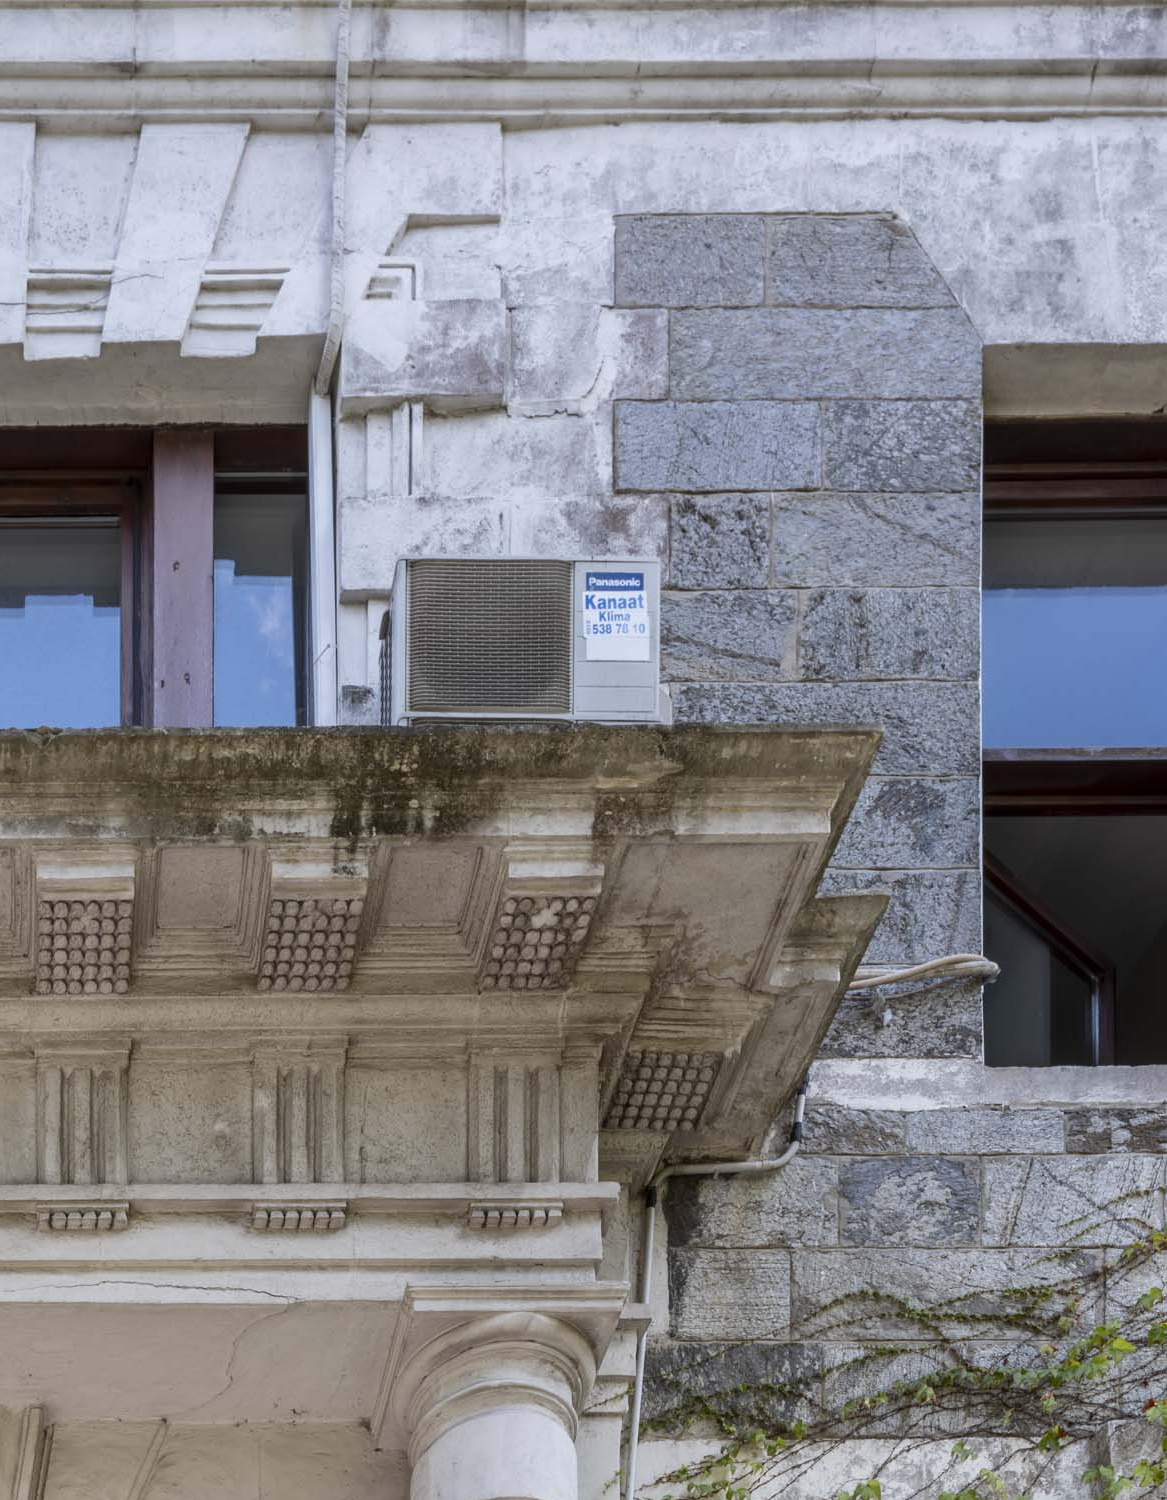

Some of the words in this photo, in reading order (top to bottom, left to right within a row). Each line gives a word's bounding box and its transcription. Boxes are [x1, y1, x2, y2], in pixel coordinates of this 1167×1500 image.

[588, 577, 641, 587] Panasonic
[584, 594, 644, 610] Kanaat
[598, 611, 631, 622] Klima
[592, 624, 612, 634] 538
[633, 623, 645, 634] 10
